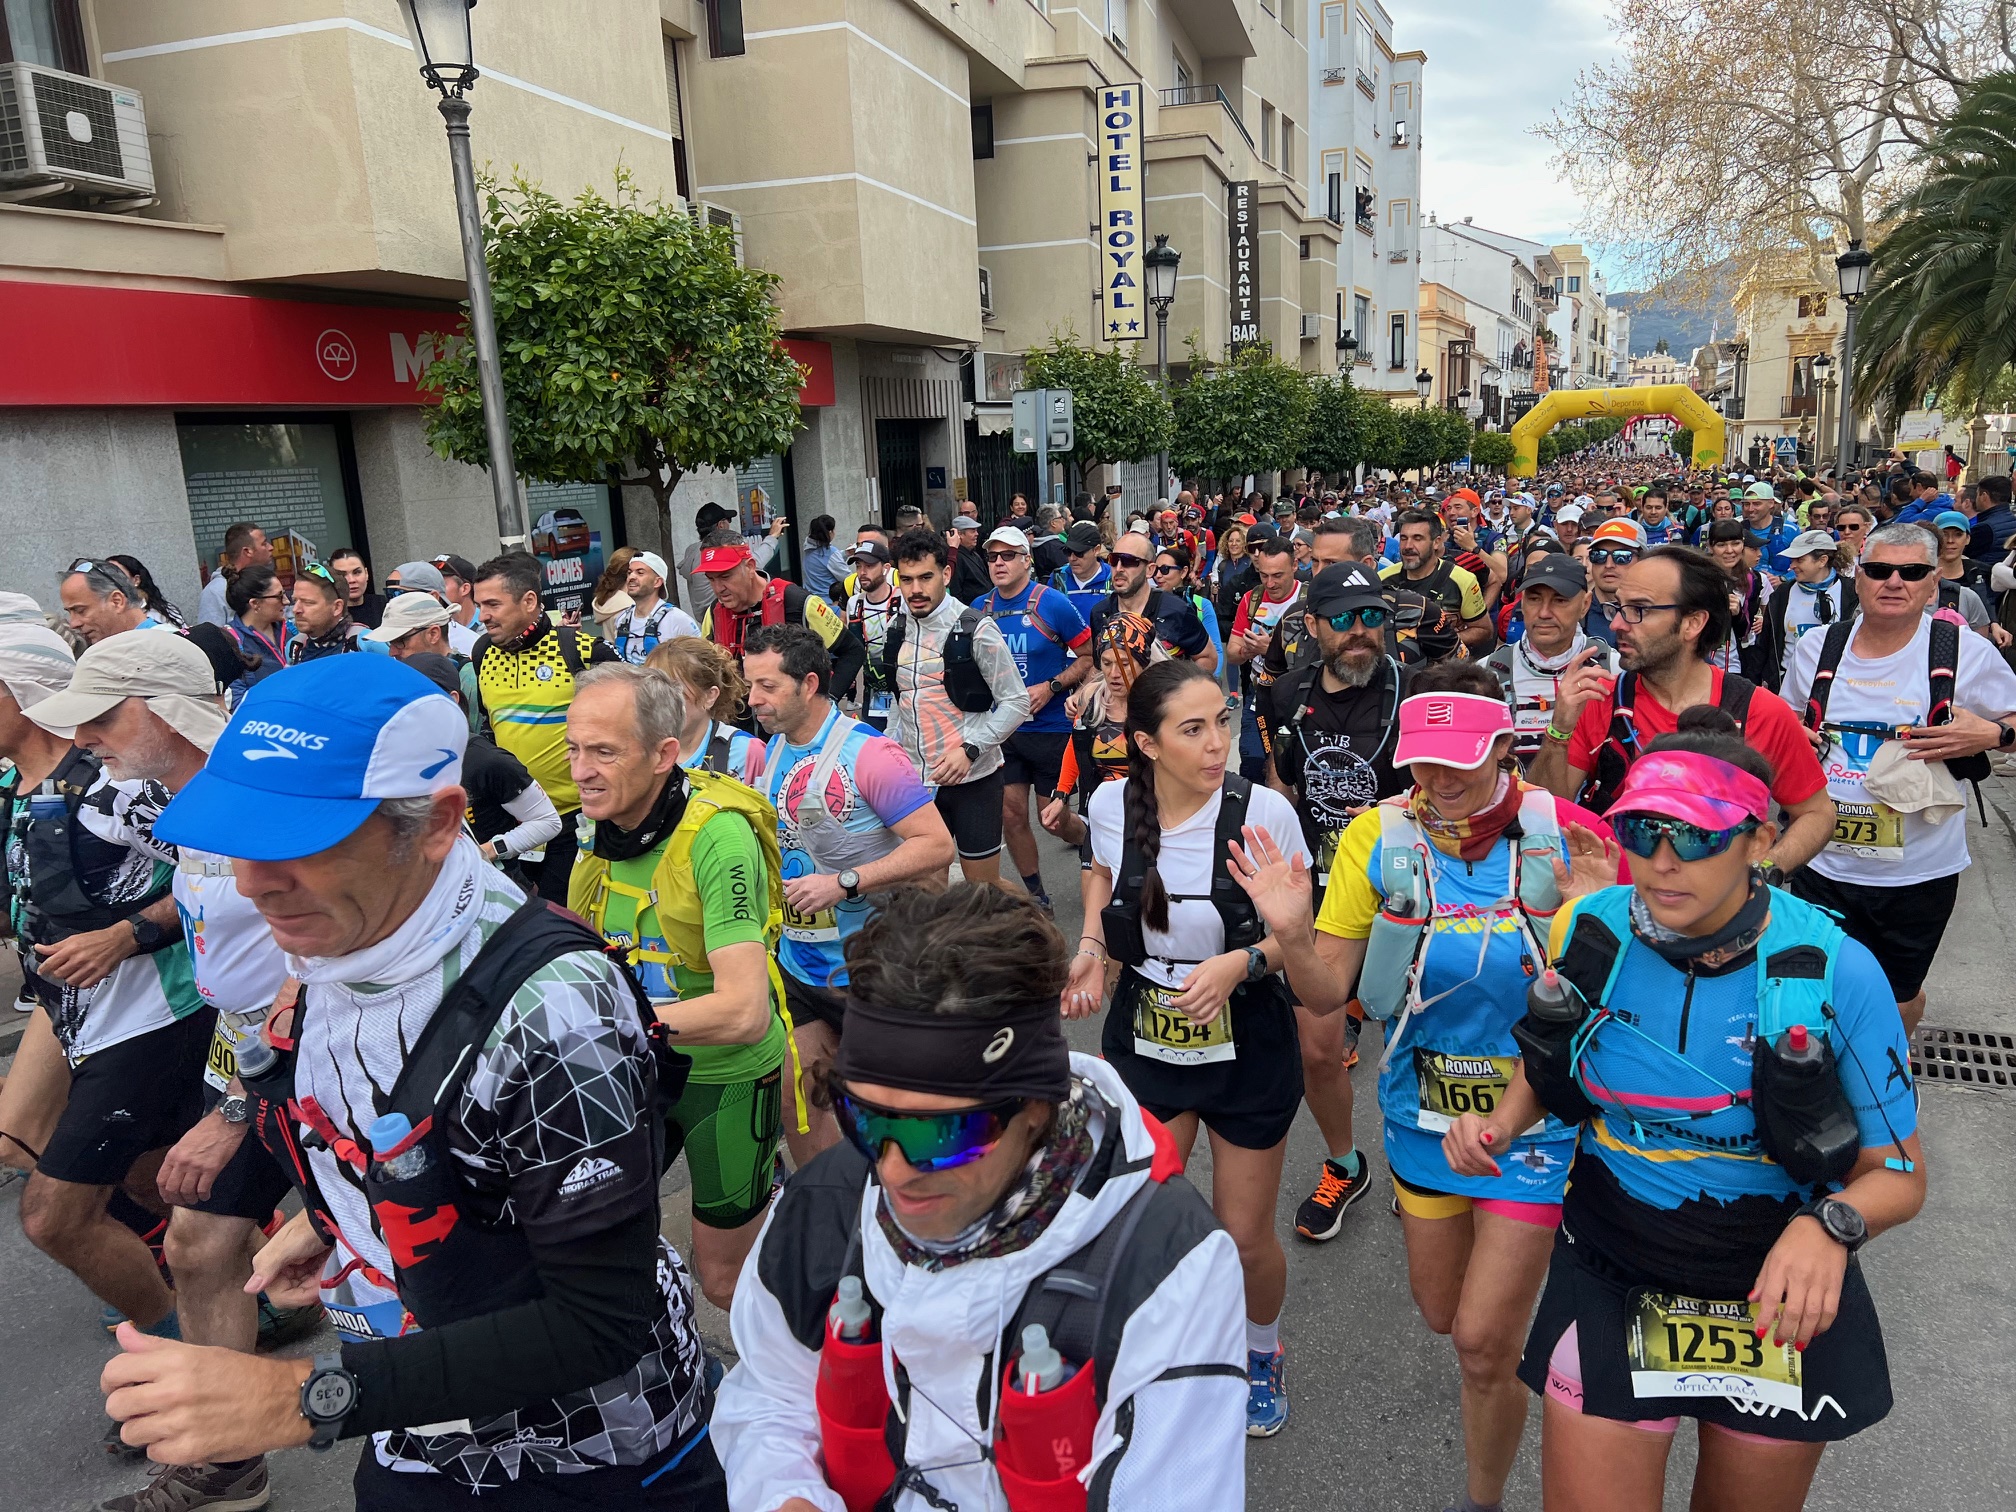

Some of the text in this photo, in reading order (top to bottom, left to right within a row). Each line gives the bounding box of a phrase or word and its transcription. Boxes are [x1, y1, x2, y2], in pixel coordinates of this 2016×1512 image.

[1105, 89, 1136, 309] HOTEL ROYAL
[1236, 185, 1251, 321] RESTAURANTE
[1232, 323, 1258, 343] BAR
[546, 556, 583, 586] COCHES
[240, 720, 330, 751] BROOKS
[1838, 802, 1874, 816] RONDA
[1835, 819, 1878, 843] 573
[729, 863, 751, 920] WONG
[1150, 1009, 1212, 1044] 1254
[1186, 1054, 1208, 1063] BACA
[1445, 1058, 1494, 1075] RONDA
[1663, 1322, 1764, 1368] 1253
[1725, 1383, 1759, 1398] BACA
